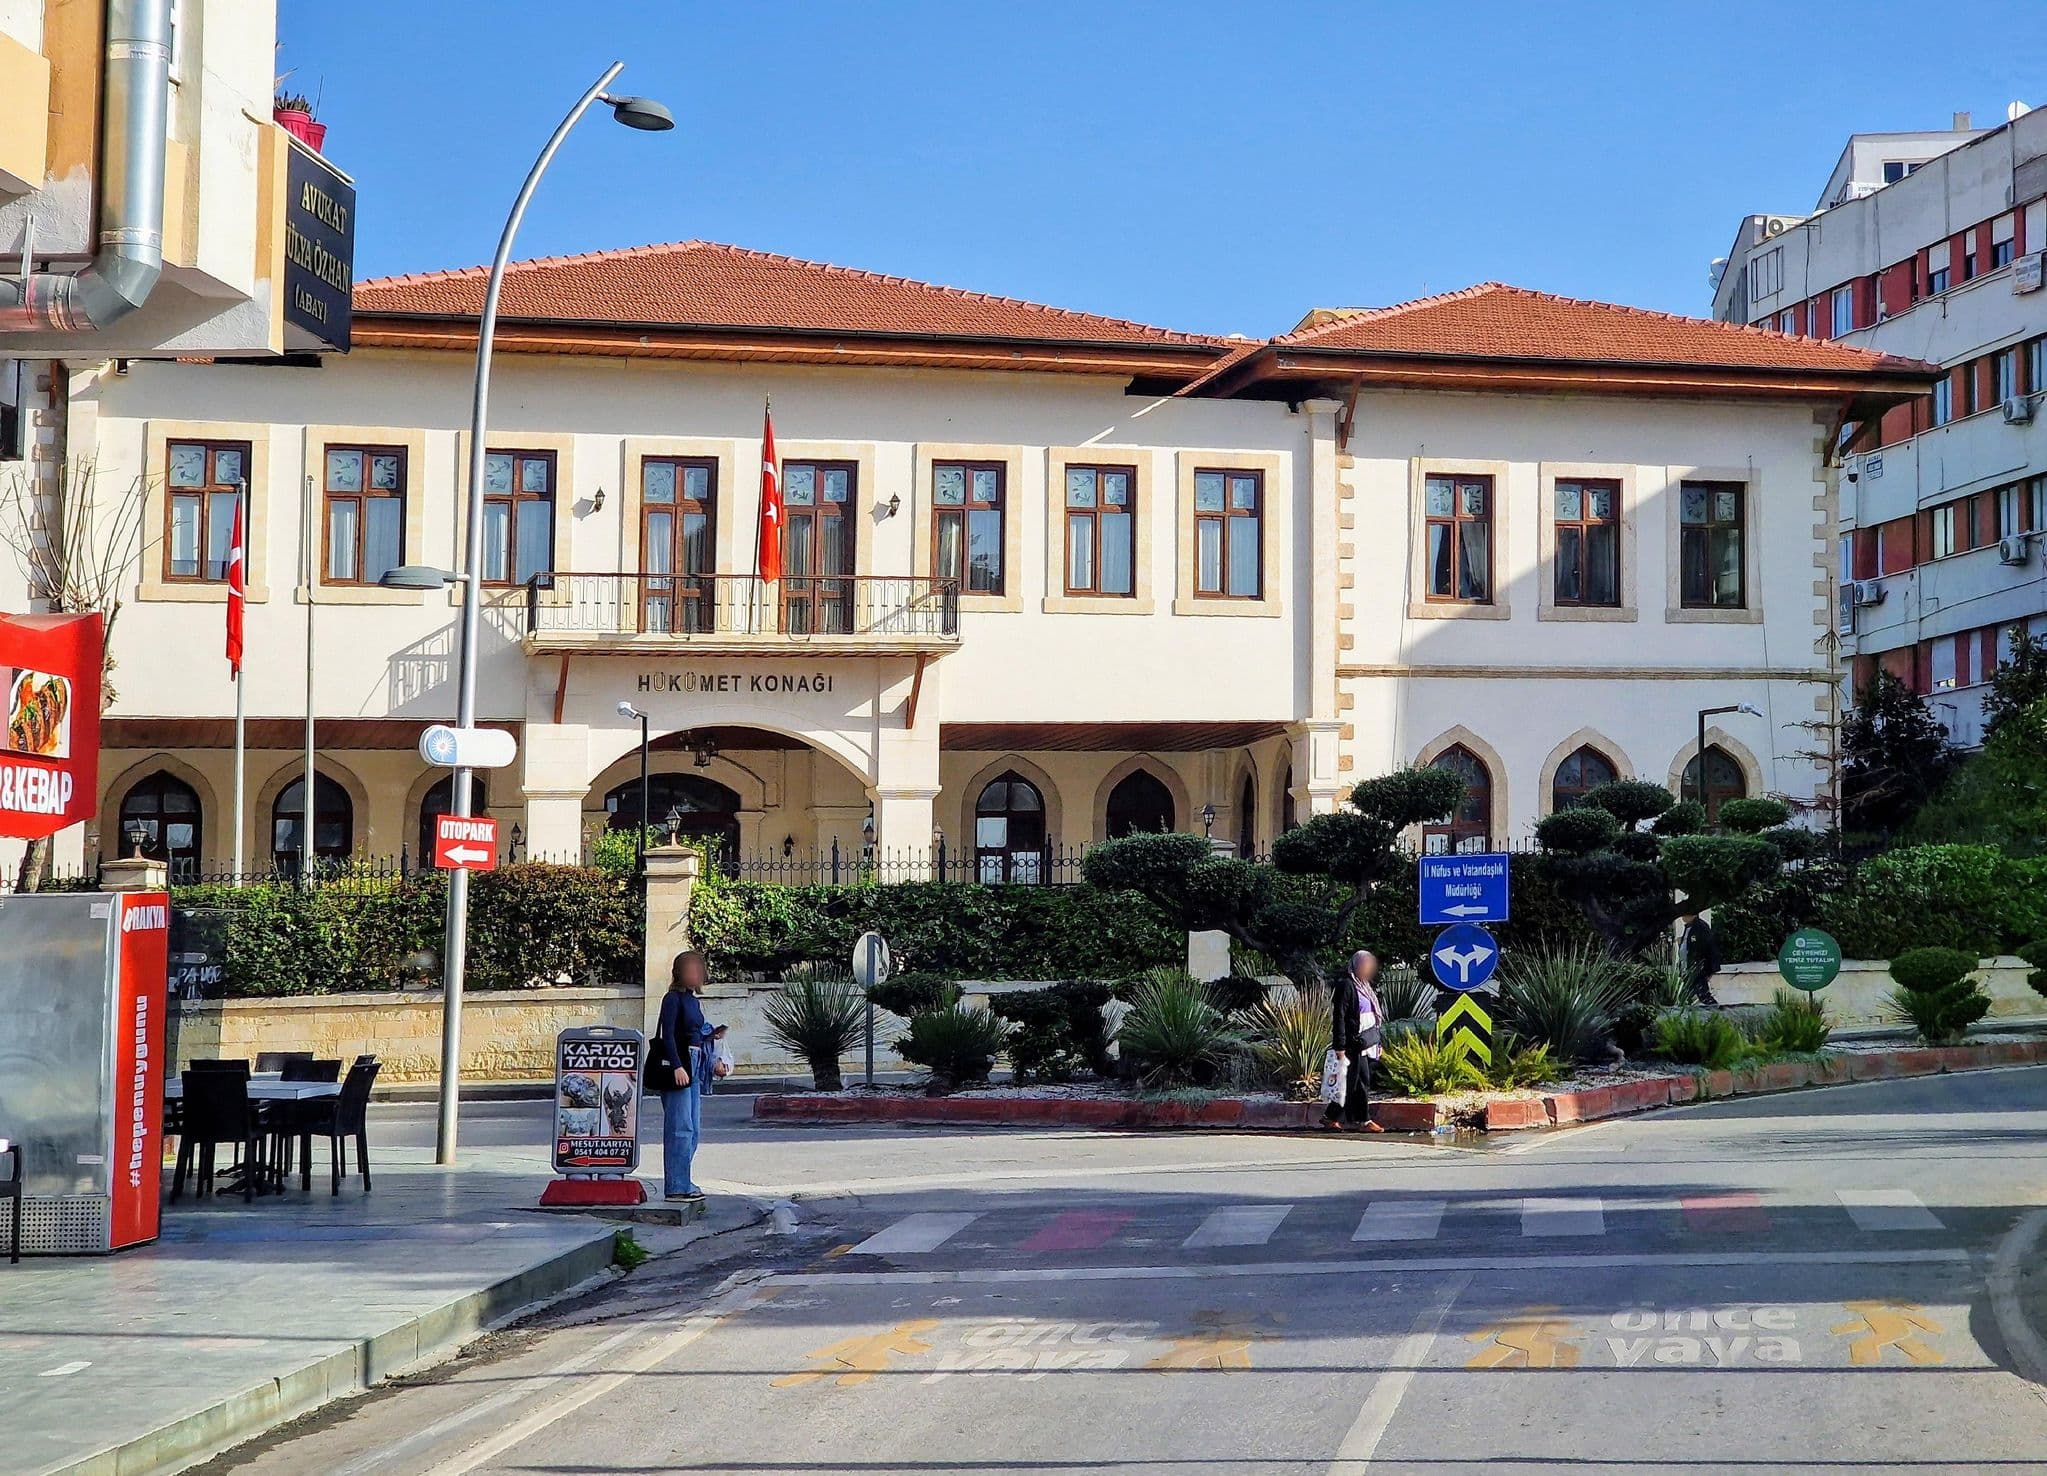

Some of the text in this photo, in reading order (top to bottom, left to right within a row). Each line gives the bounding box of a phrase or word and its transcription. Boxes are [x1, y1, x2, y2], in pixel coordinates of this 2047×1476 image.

[301, 181, 347, 235] AVUKAT
[286, 220, 350, 295] ÜLYA ÖZHAN
[295, 283, 327, 325] (ABAY)
[637, 671, 833, 692] HÜKÜMET KONAĞI
[0, 765, 73, 815] &KEBAP
[440, 820, 495, 842] OTOPARK
[1431, 864, 1452, 878] Nüfus
[1452, 868, 1461, 877] ve
[1462, 862, 1504, 879] Vatandaşlık
[1445, 883, 1482, 899] Müdürlüğü
[564, 1043, 636, 1056] KARTAL
[565, 1056, 635, 1068] TATTOO
[1606, 1336, 1802, 1368] yaya
